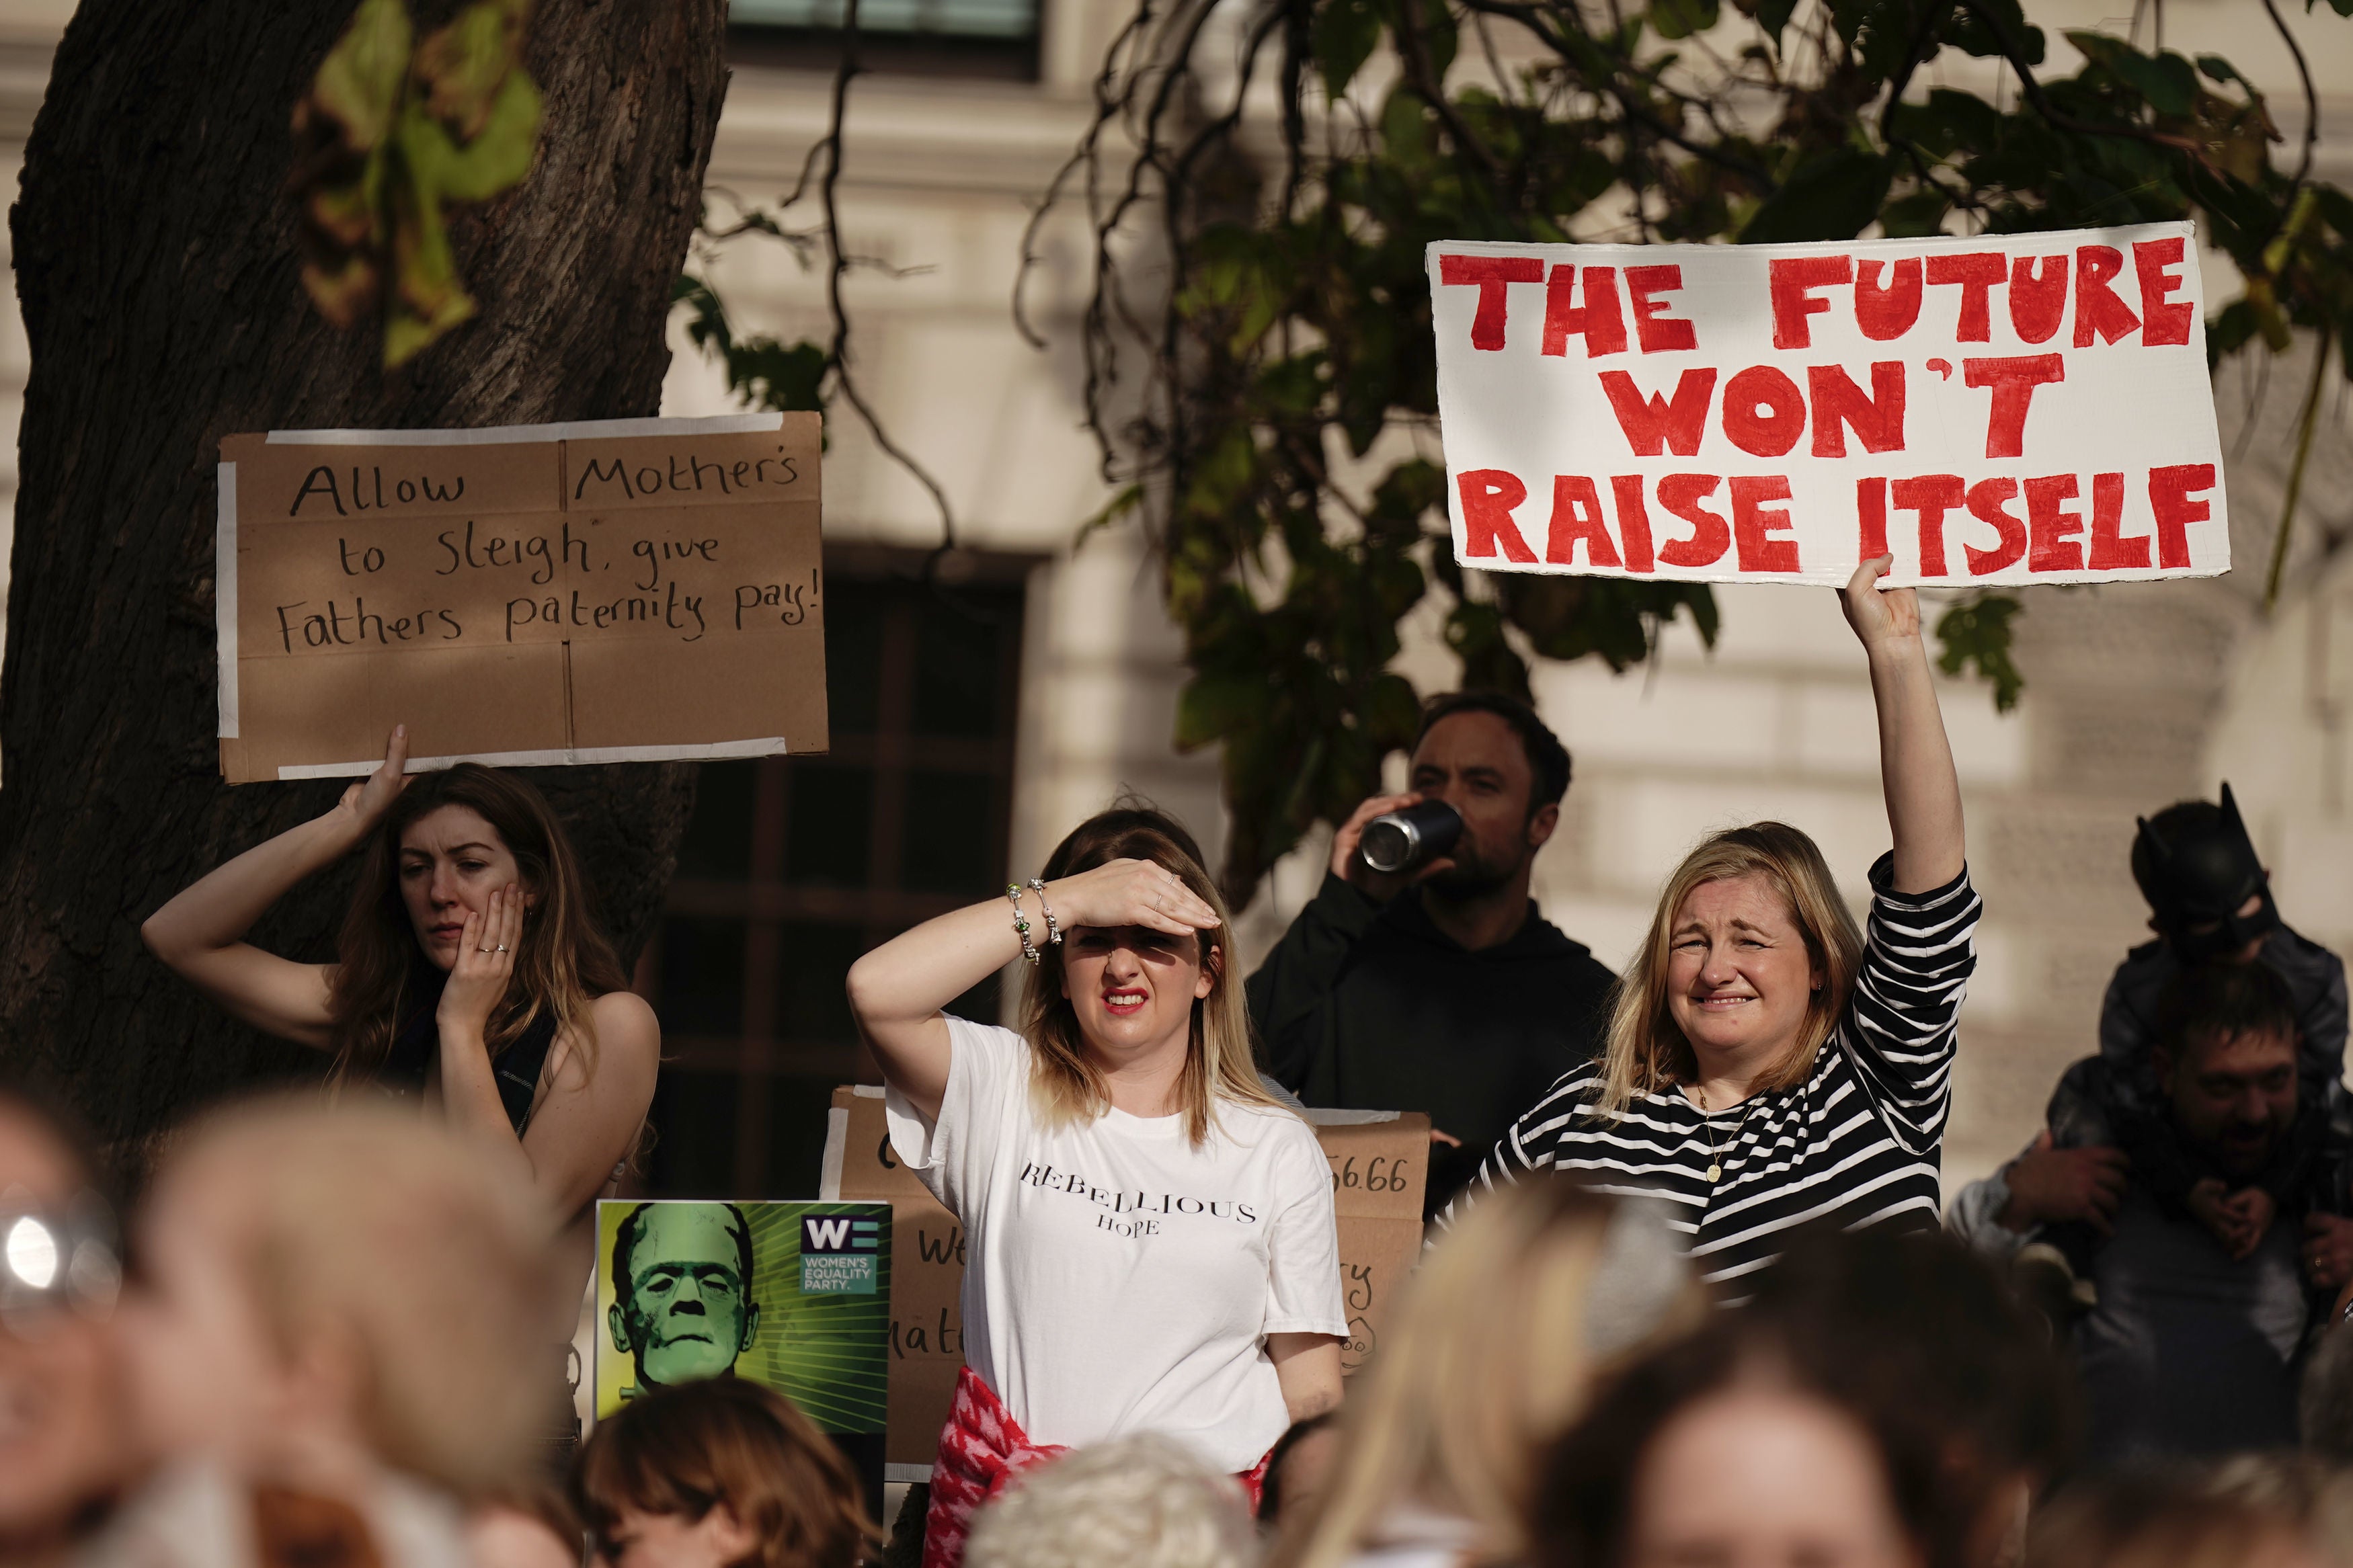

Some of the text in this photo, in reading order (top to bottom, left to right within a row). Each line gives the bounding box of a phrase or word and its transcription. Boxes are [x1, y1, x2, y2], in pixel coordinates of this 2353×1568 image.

[1440, 237, 2194, 358] THE FUTURE
[1598, 353, 2065, 458] WON'T
[290, 446, 797, 516] Allow Mother's
[1457, 464, 2216, 577] RAISE ITSELF
[339, 538, 385, 575] to
[633, 539, 718, 591] give
[276, 569, 817, 655] Fathers paternity pay!
[1020, 1157, 1256, 1224] REBELLIOUS
[1096, 1213, 1160, 1239] HOPE
[804, 1268, 871, 1280] EQUALITY
[804, 1279, 852, 1290] PARTY.
[805, 1257, 868, 1269] WOMEN'S
